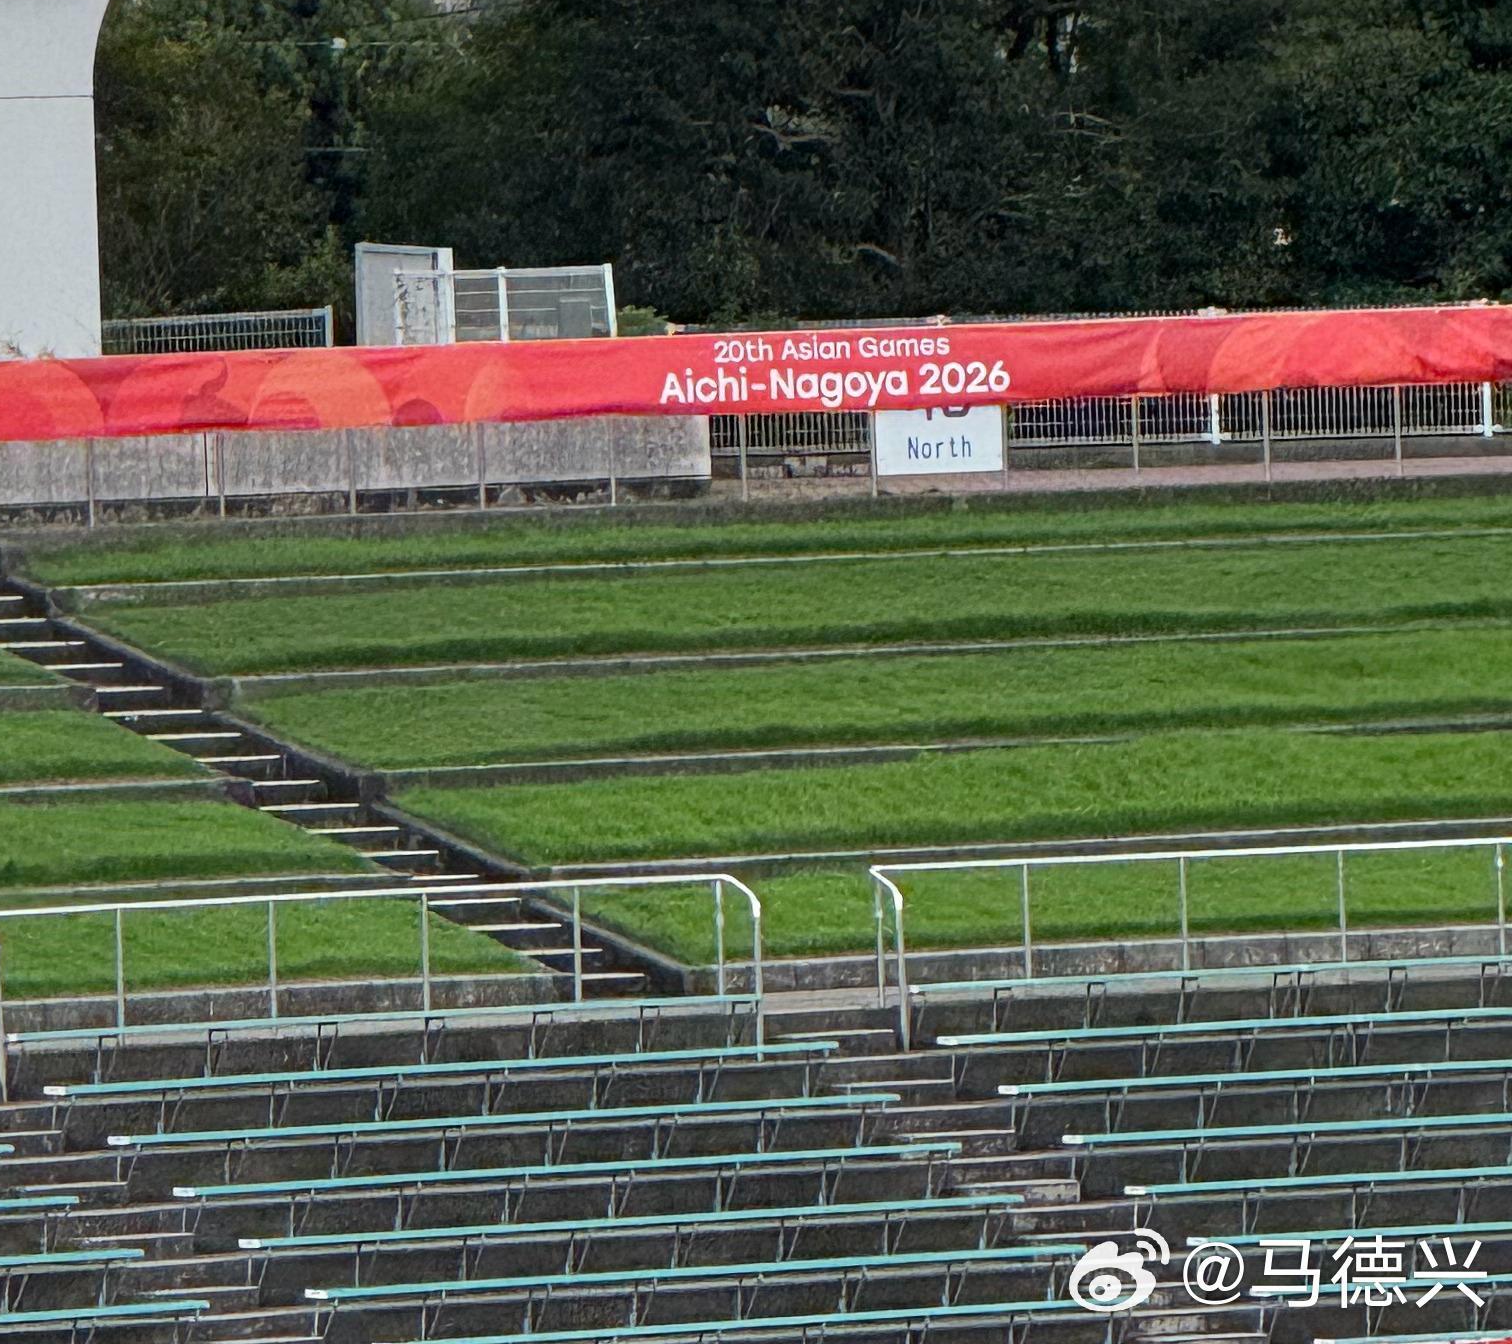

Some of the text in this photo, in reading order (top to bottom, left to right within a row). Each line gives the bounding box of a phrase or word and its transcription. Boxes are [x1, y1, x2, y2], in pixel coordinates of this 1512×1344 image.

[713, 335, 951, 364] 20th Asian Games
[659, 359, 1011, 408] Aichi-Nagoya 2026
[907, 435, 972, 460] North
